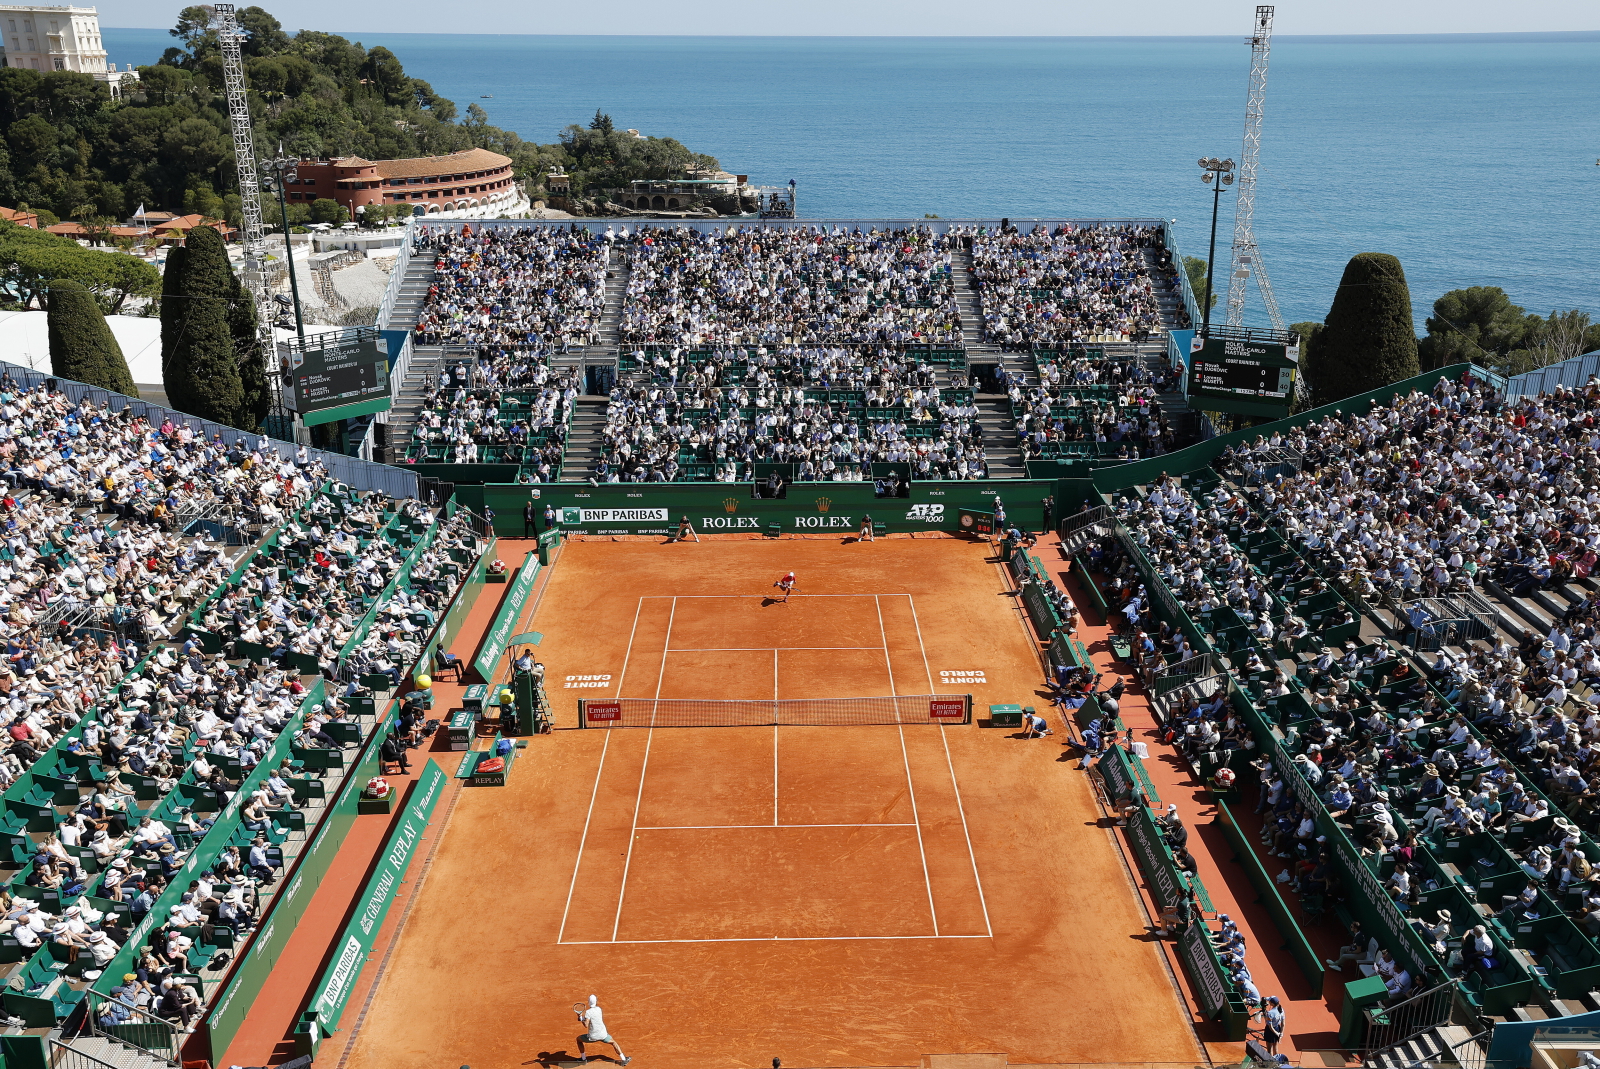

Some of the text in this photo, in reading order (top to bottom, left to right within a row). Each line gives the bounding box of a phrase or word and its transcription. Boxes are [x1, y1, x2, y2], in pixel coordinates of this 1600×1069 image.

[584, 510, 662, 520] BNP PARIBAS
[702, 517, 760, 527] ROLEX
[795, 516, 852, 527] ROLEX
[906, 504, 945, 516] ATP
[511, 583, 526, 610] REPLAY
[420, 770, 442, 810] Maserati
[1107, 754, 1126, 793] Malongo
[1274, 742, 1322, 815] MONTE-CARLO BAY
[1276, 755, 1291, 785] HOTEL
[389, 820, 417, 871] REPLAY
[1136, 824, 1160, 870] Sergio Tacchini
[367, 868, 394, 919] GENERALI
[1336, 844, 1362, 886] SOCIÉTÉ
[1363, 884, 1376, 905] DES
[1377, 900, 1398, 936] BAINS
[1399, 933, 1410, 953] DE
[1357, 859, 1405, 930] MONTE-CARLO
[142, 913, 154, 935] WELLS
[326, 942, 358, 1002] BNP PARIBAS
[1193, 942, 1224, 1003] BNP PARIBAS
